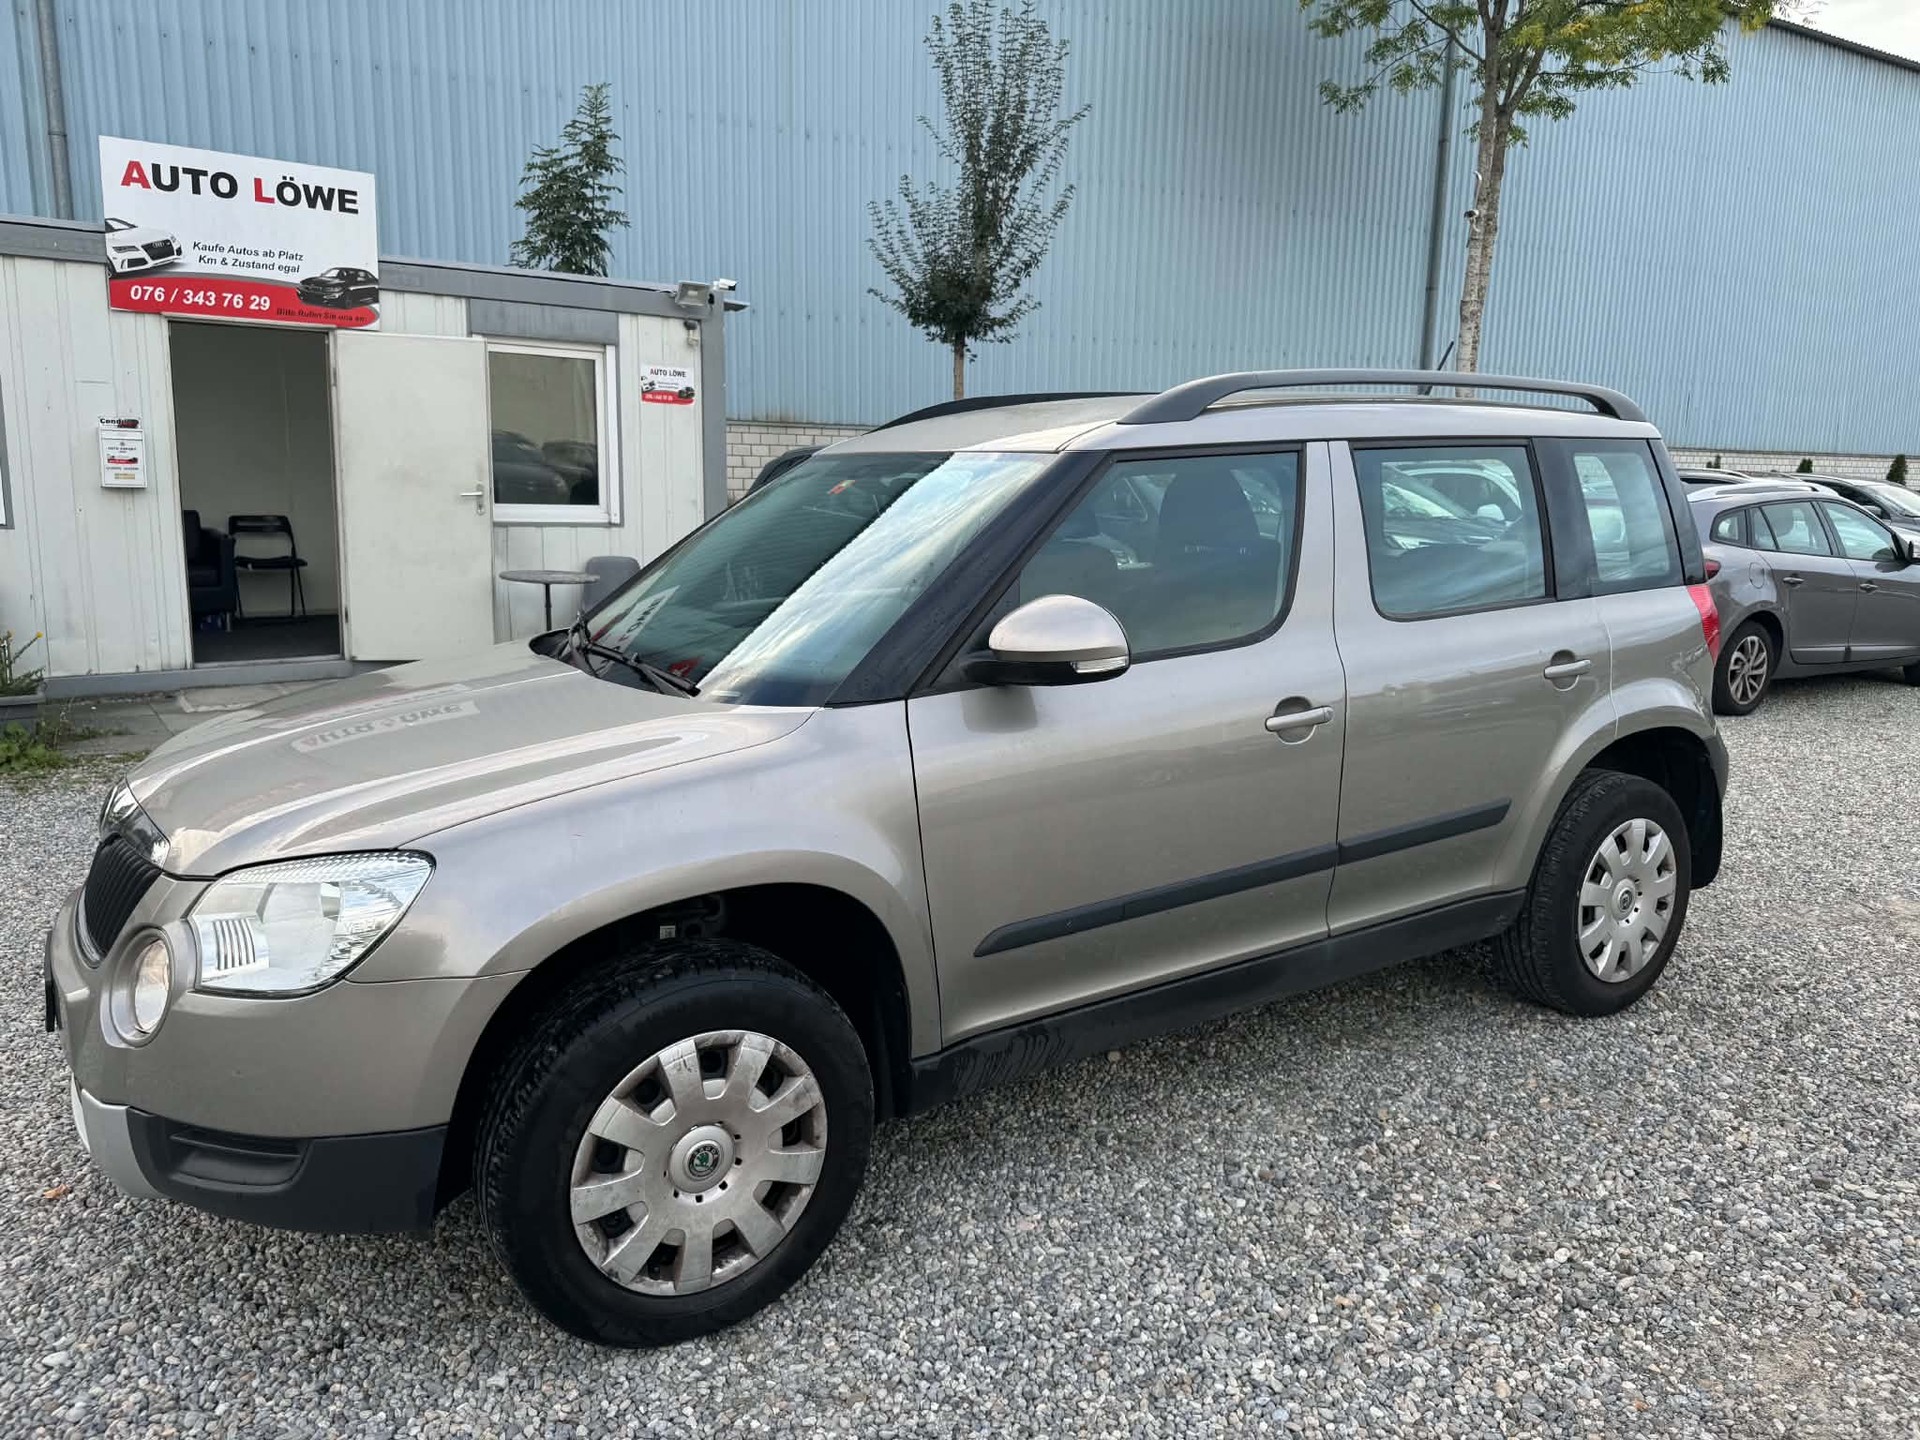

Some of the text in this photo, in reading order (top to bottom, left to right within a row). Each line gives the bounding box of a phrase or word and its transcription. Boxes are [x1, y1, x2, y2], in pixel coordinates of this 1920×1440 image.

[120, 160, 359, 215] AUTO LÖWE
[192, 241, 304, 262] Kaufe Autos ab Platz
[198, 254, 300, 274] Km & Zustand egal
[130, 285, 271, 311] 076 / 343 76 29
[650, 368, 668, 376] AUTO
